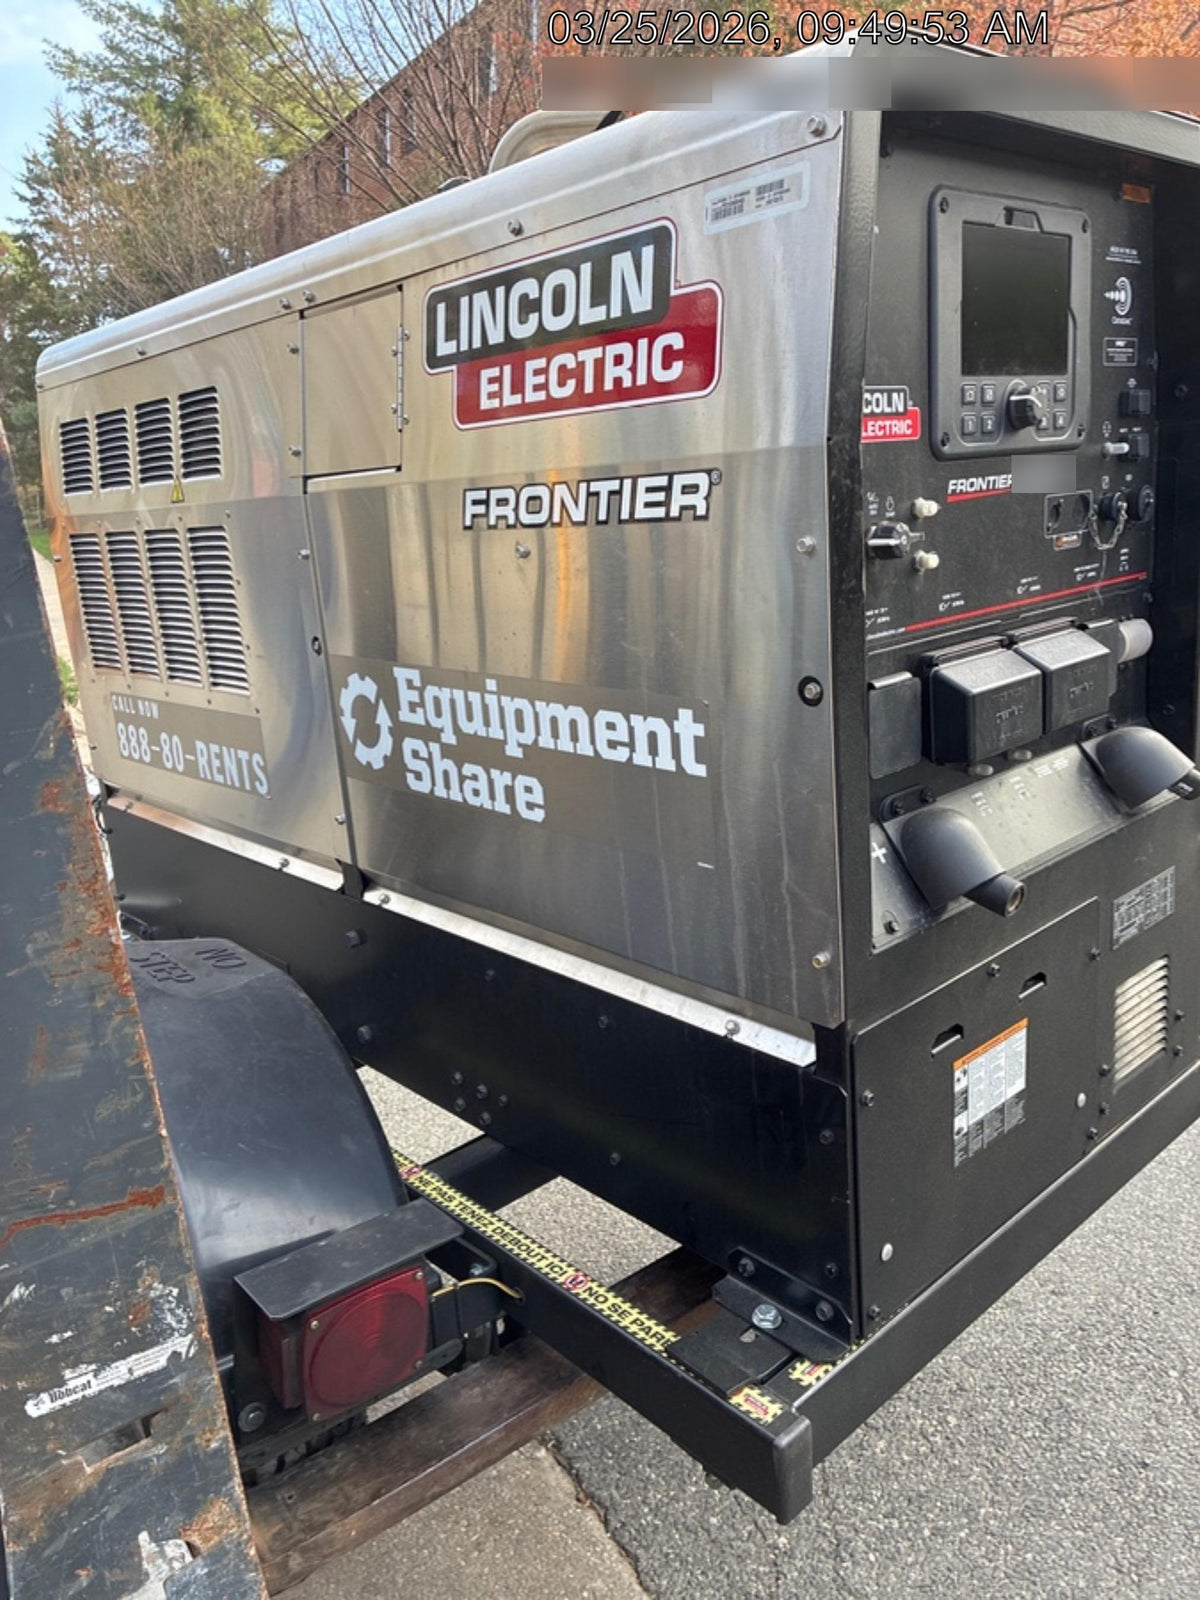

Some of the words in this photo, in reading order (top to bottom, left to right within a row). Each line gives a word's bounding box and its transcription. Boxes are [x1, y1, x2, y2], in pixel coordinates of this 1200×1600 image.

[436, 244, 655, 357] LINCOLN
[480, 332, 684, 411] ELECTRIC
[862, 391, 904, 413] COLN
[861, 419, 912, 437] LECTRIC
[111, 694, 136, 715] CALL
[138, 699, 159, 719] NOW
[392, 666, 707, 777] Equipment
[117, 722, 269, 795] 888-80-RENTS
[402, 737, 546, 823] Share
[491, 1225, 550, 1264] DEBOUT
[545, 1260, 569, 1278] ICI
[583, 1286, 609, 1304] NO
[607, 1302, 634, 1320] SE
